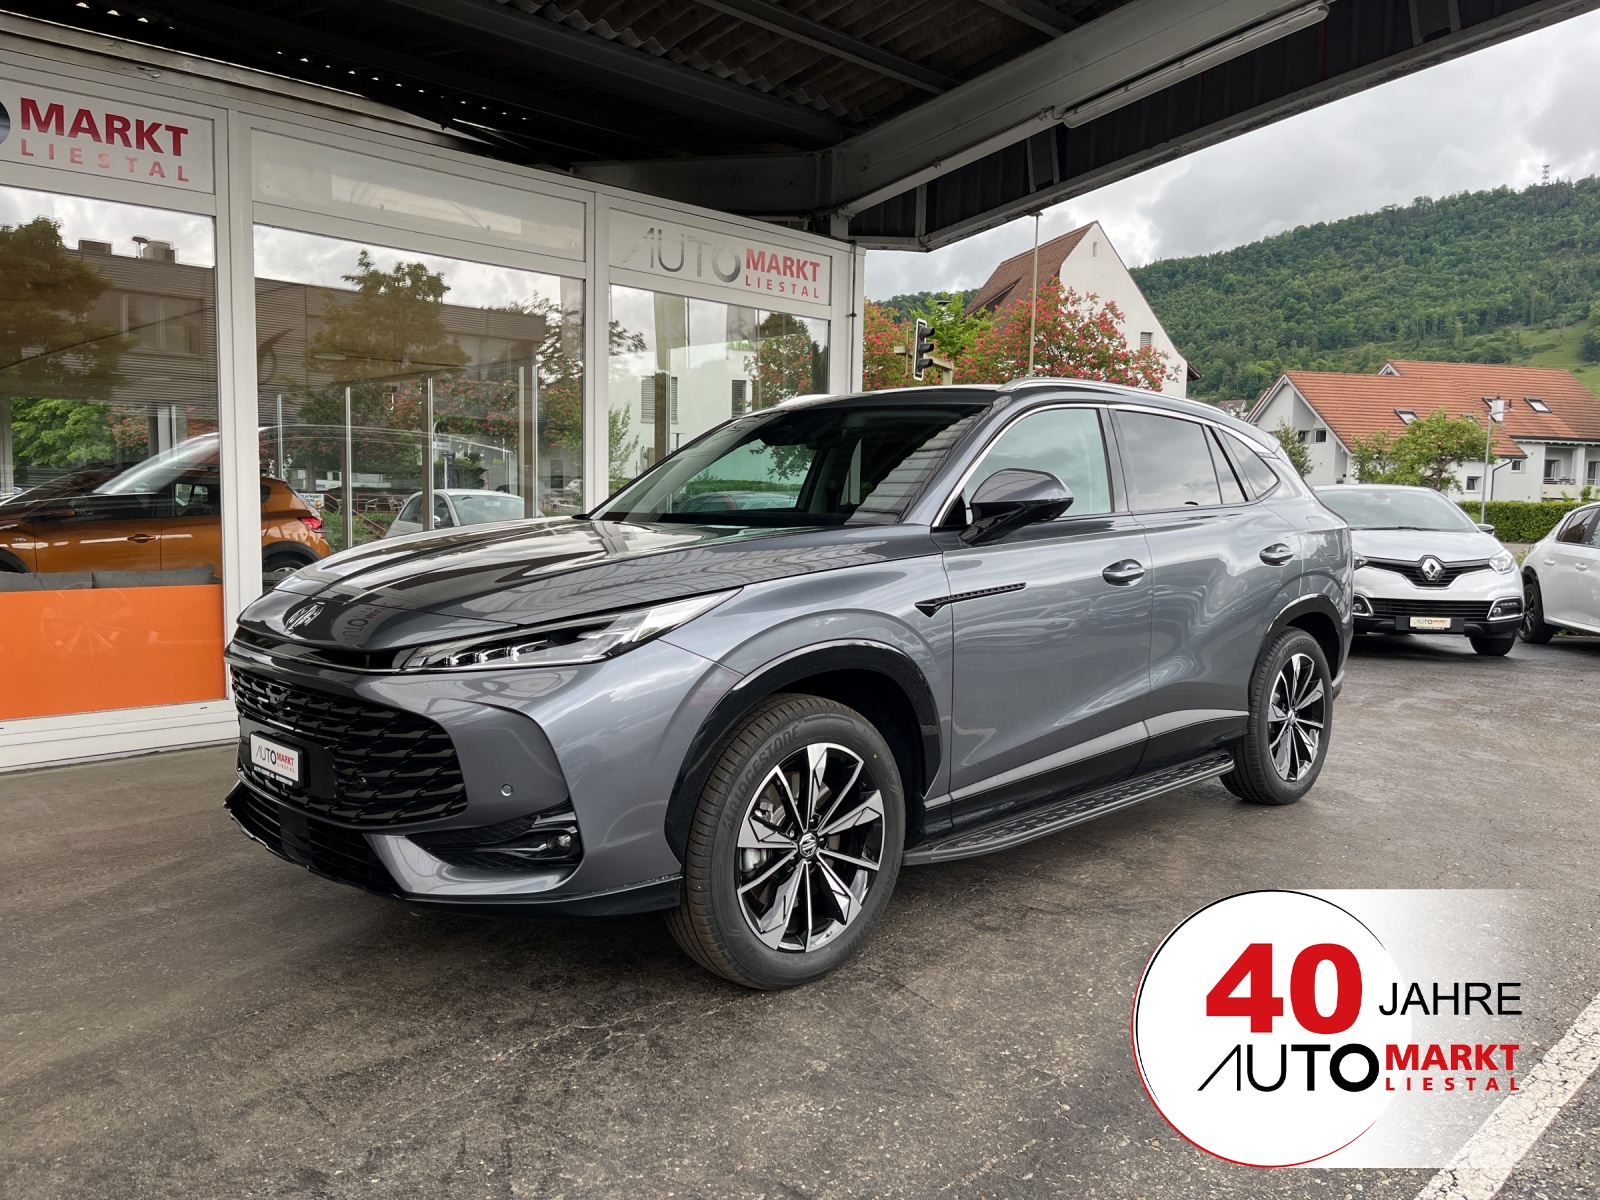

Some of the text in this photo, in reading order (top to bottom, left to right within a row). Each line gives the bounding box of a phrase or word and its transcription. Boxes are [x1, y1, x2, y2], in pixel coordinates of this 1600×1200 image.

[20, 97, 189, 157] MARKT
[20, 138, 190, 182] LIESTAL
[621, 227, 820, 283] AUTO MARKT
[745, 275, 820, 299] LIESTAL
[255, 745, 277, 765] AUTO
